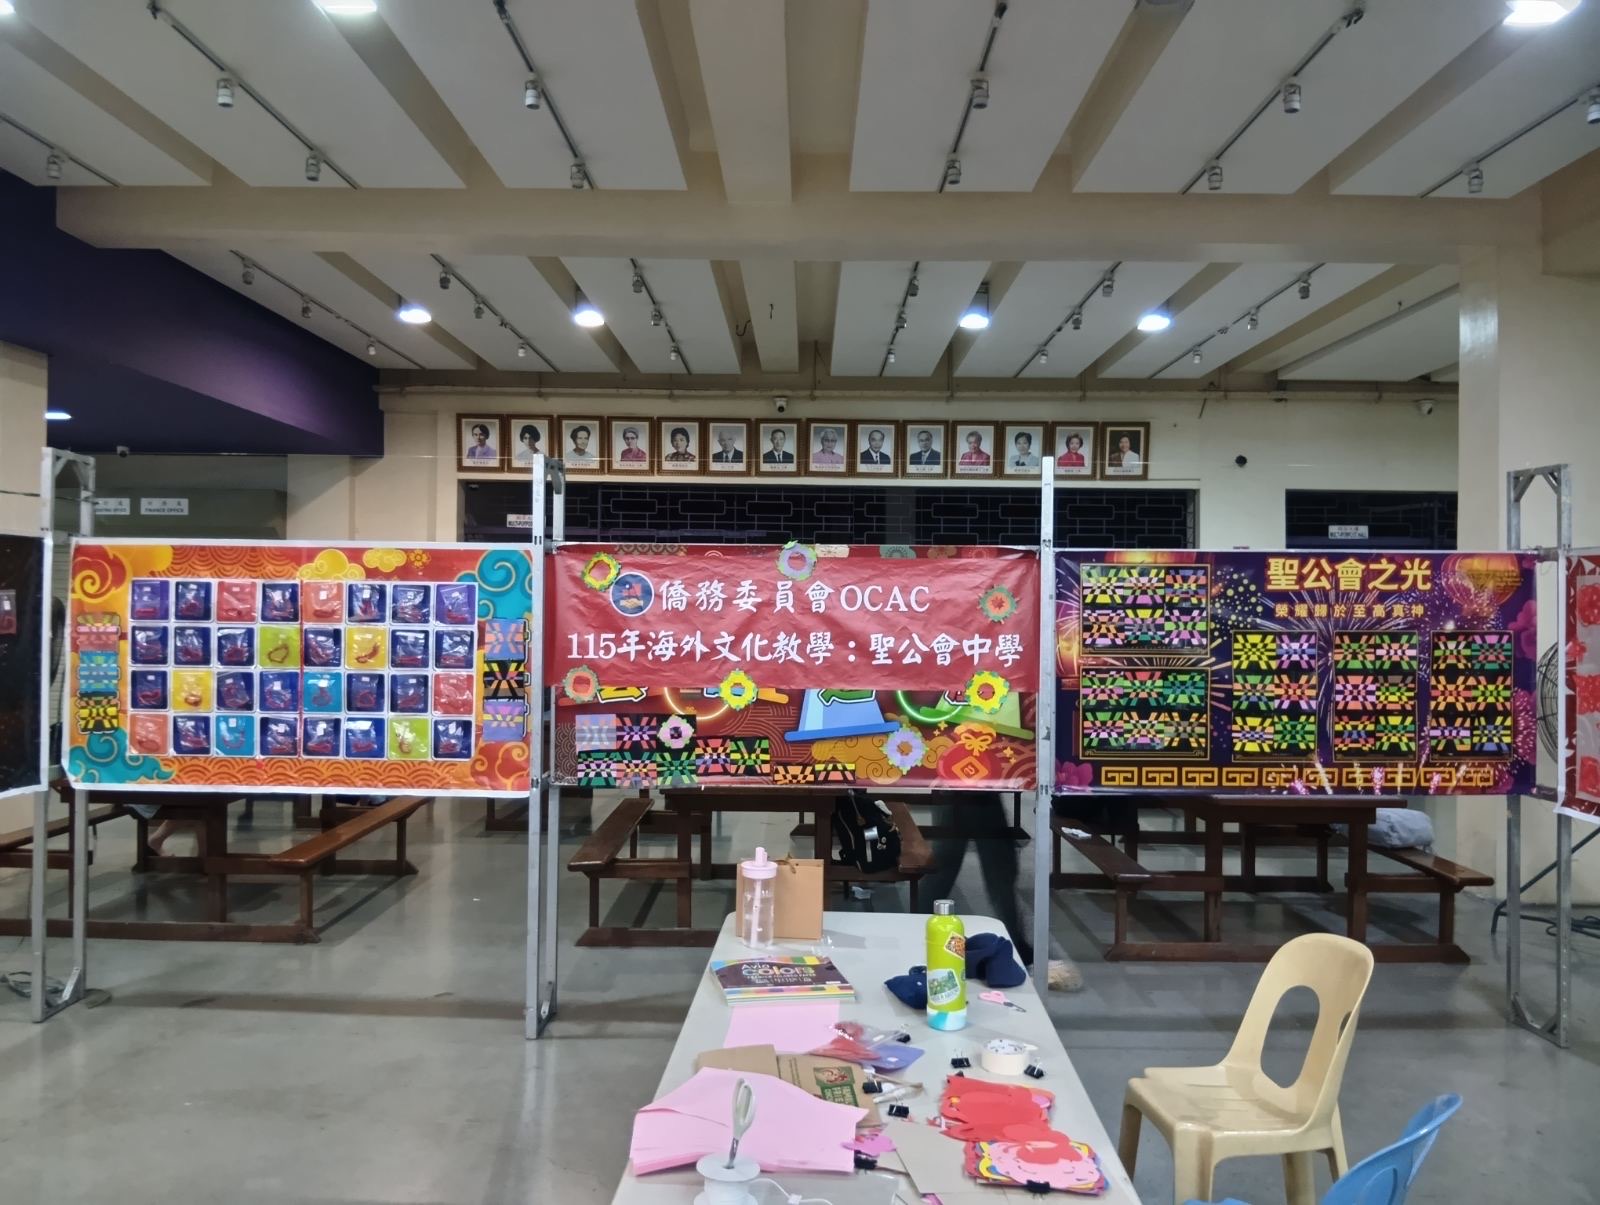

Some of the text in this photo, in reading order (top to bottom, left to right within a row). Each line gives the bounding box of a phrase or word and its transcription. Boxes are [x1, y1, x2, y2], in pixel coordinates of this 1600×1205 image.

[1266, 557, 1432, 591] 聖公會之光
